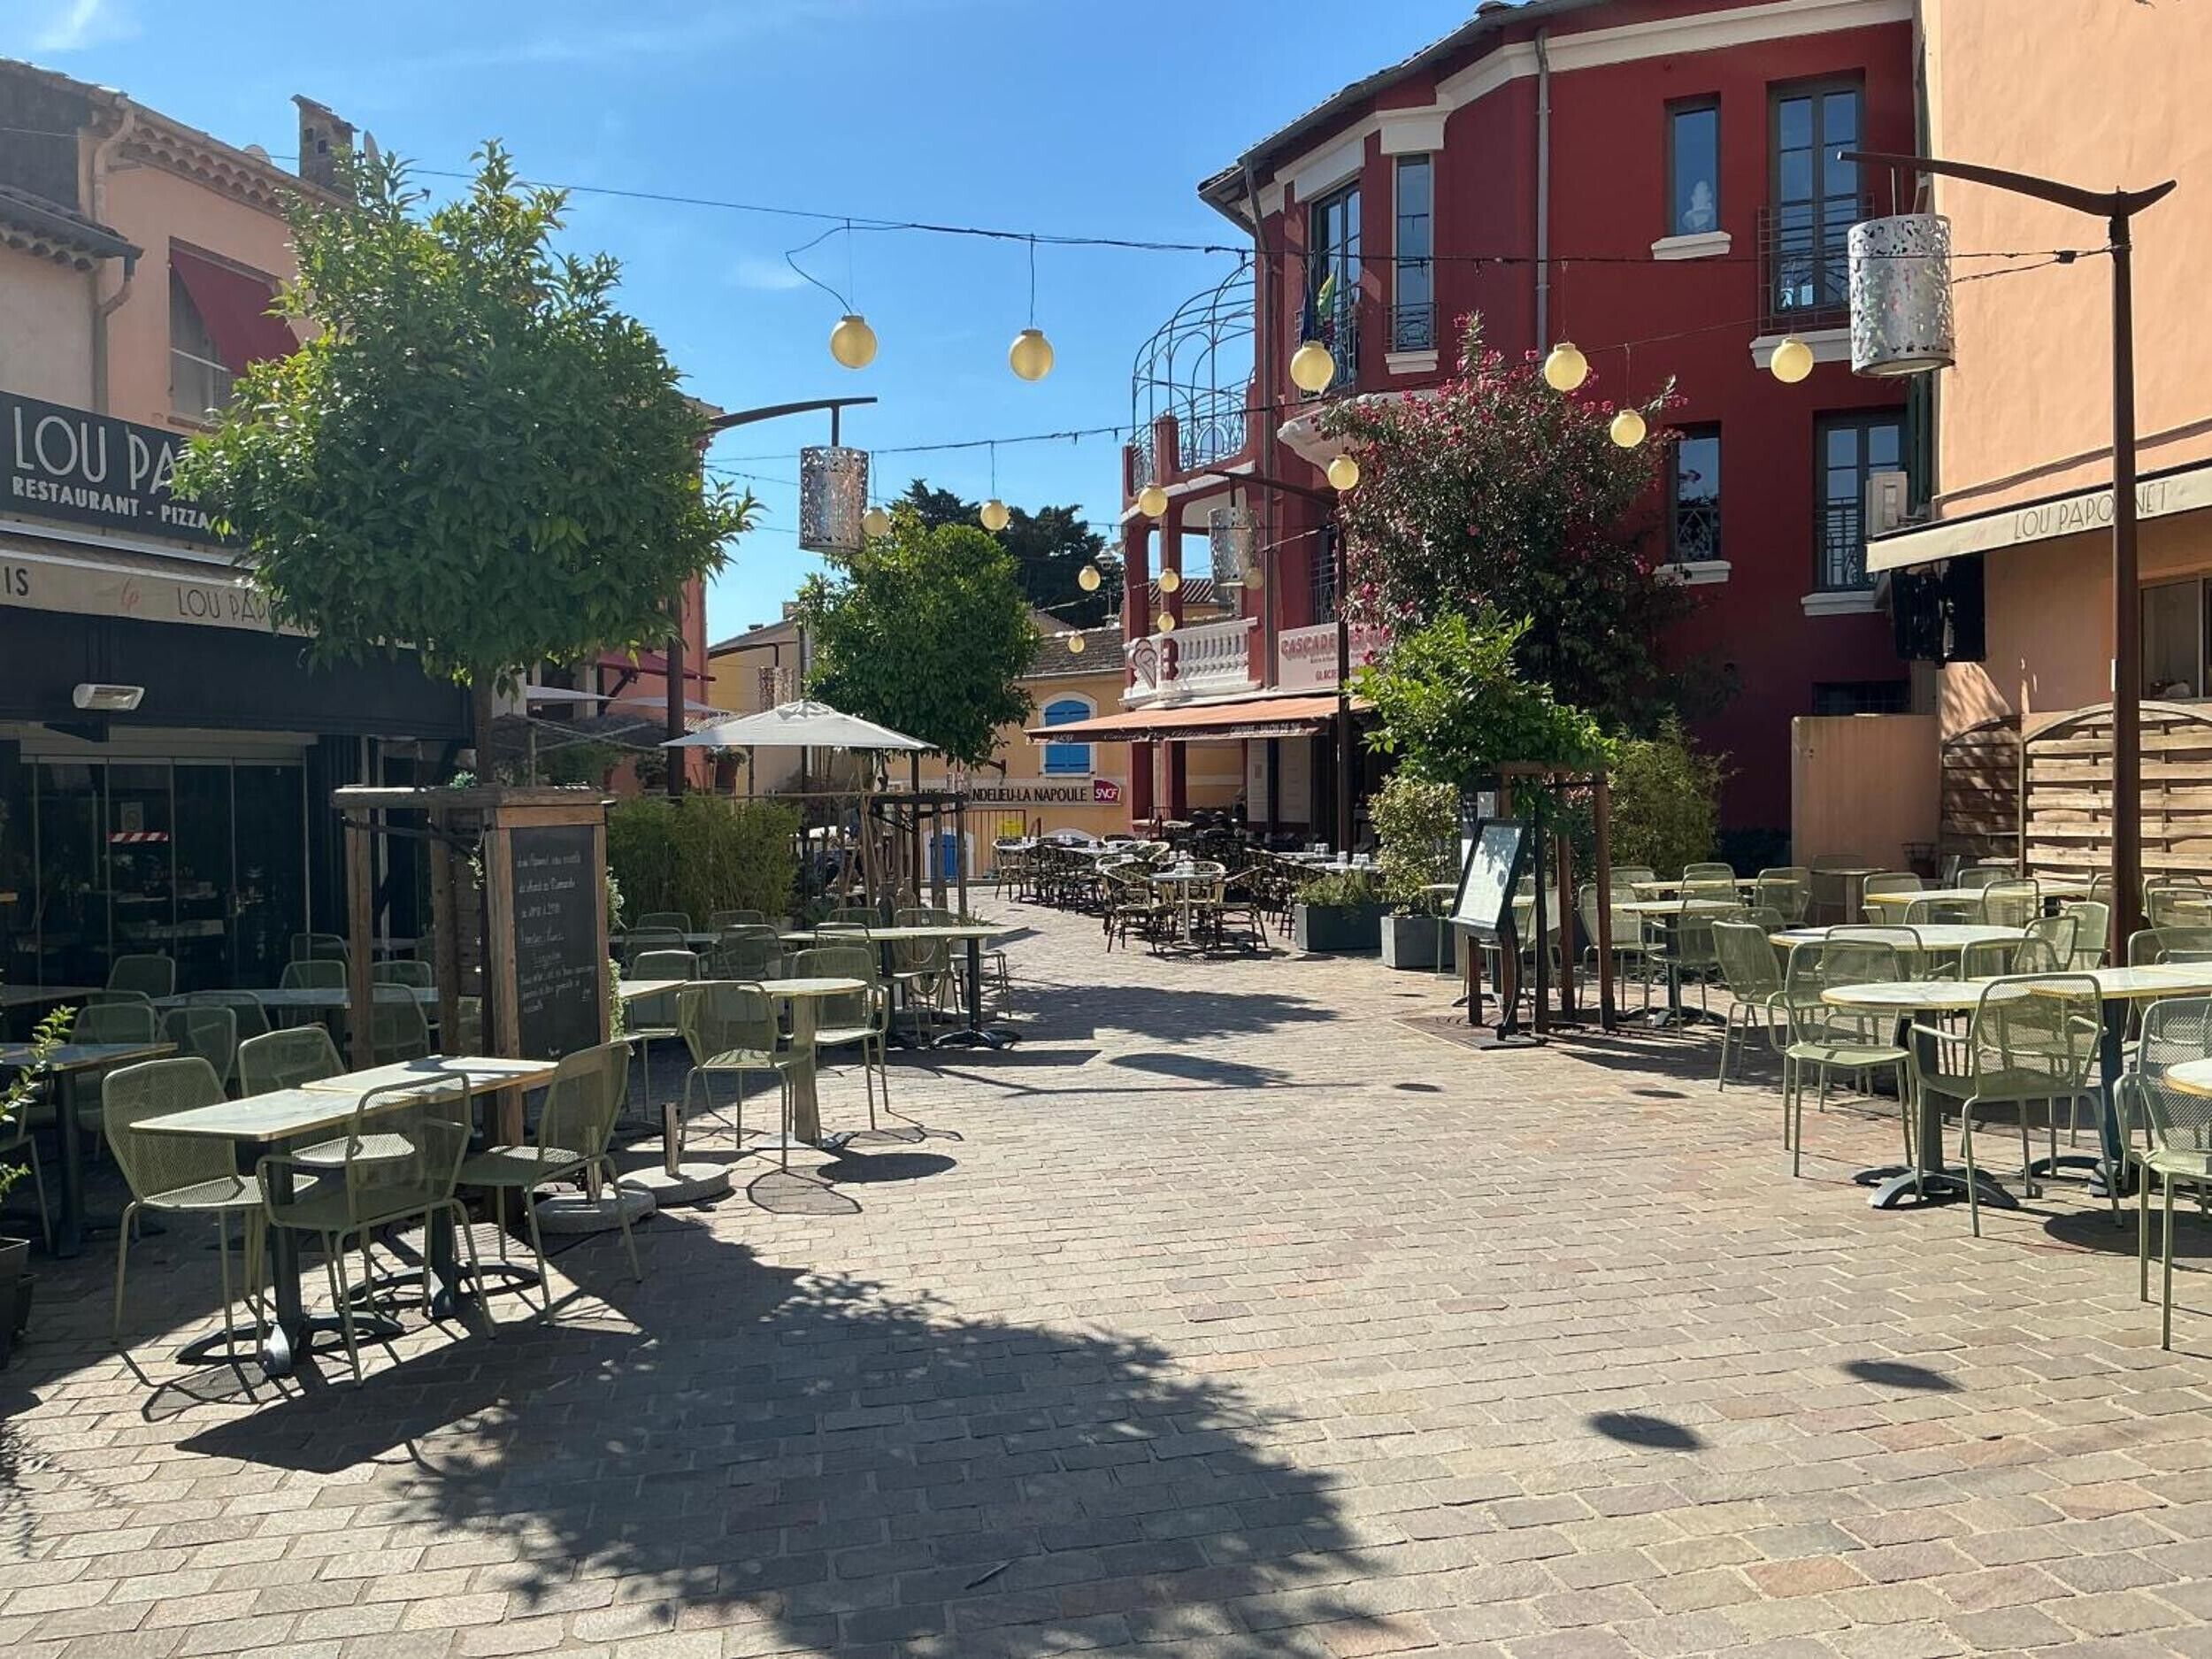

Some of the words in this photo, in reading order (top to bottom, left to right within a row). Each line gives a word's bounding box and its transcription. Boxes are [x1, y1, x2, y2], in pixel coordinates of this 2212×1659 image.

[13, 405, 107, 483] LOU
[125, 423, 178, 495] PA
[12, 475, 140, 518] RESTAURANT
[2014, 506, 2051, 541] LOU
[2059, 480, 2171, 532] PAPONET
[176, 586, 221, 619] LOU
[972, 787, 1032, 802] NDELIEU-LA
[1033, 787, 1087, 802] NAPOULE
[1094, 787, 1119, 799] SNCF
